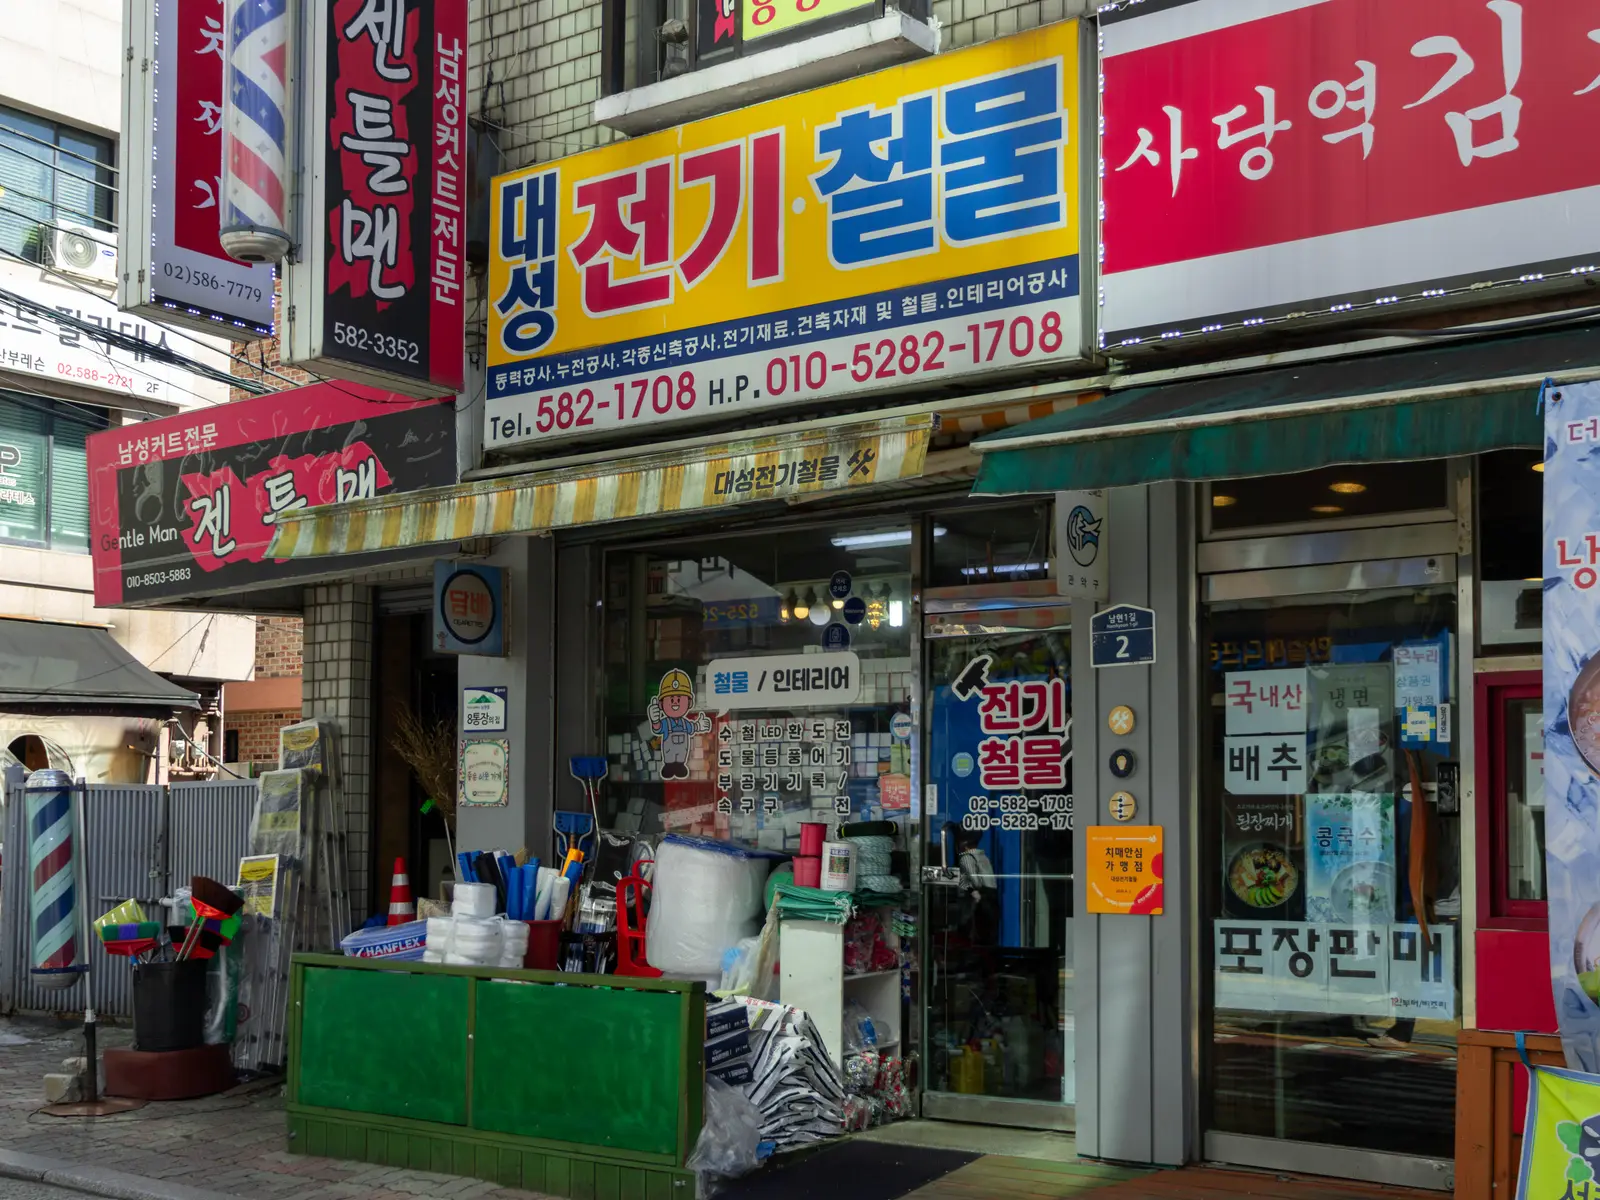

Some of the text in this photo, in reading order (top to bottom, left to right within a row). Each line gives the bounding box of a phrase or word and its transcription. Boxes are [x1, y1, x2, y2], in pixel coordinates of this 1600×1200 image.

[1115, 60, 1376, 198] 사당역
[431, 32, 463, 306] 남성컷트전문
[493, 167, 561, 356] 대성
[163, 261, 262, 303] 02)586-7779
[876, 301, 892, 321] 및
[334, 321, 420, 365] 582-3352
[57, 362, 134, 389] 02.588-2721
[146, 382, 160, 394] 2F
[118, 422, 219, 465] 남성커트전문
[713, 454, 841, 495] 대성전기철물
[101, 525, 178, 552] Gentle Man
[126, 567, 192, 589] 010-8503-5883
[448, 589, 490, 619] 담배
[1108, 612, 1136, 624] 남현1길
[1115, 635, 1130, 658] 2
[713, 670, 749, 695] 철물
[772, 666, 850, 693] 인테리어
[1227, 680, 1303, 714] 국내산
[979, 680, 1066, 733] 전기
[979, 736, 1064, 788] 철물
[1228, 742, 1303, 783] 배추
[1235, 812, 1293, 832] 된장찌개
[1316, 826, 1377, 848] 콩국수
[1105, 847, 1143, 859] 치매안심
[365, 937, 421, 957] HANFLEX
[1219, 927, 1442, 983] 포장판매
